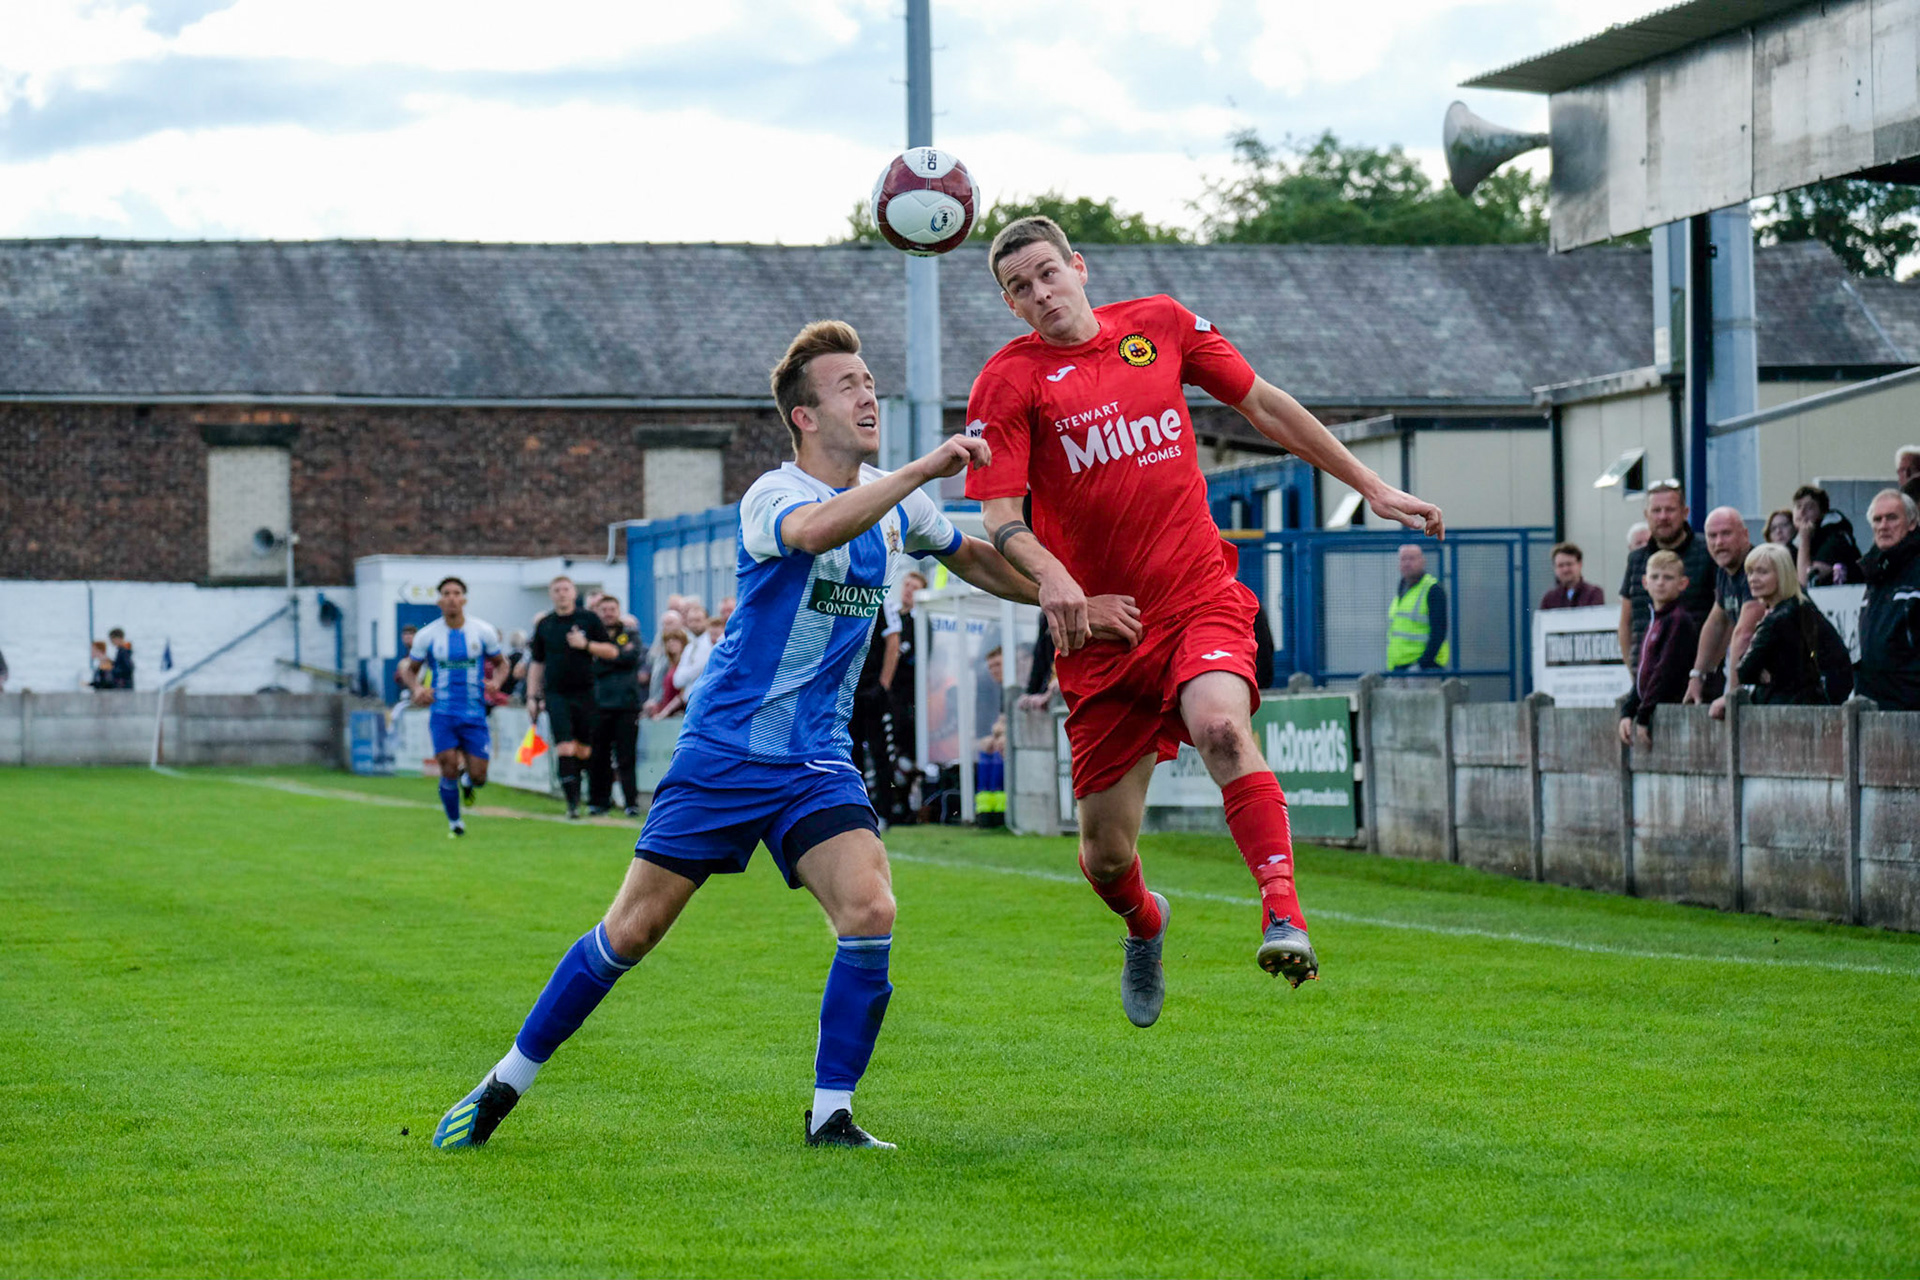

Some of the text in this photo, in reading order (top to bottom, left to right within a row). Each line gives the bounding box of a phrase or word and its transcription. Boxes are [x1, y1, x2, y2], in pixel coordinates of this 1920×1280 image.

[1054, 401, 1119, 432] STEWART
[1060, 408, 1182, 474] Milne
[1137, 445, 1182, 467] HOMES
